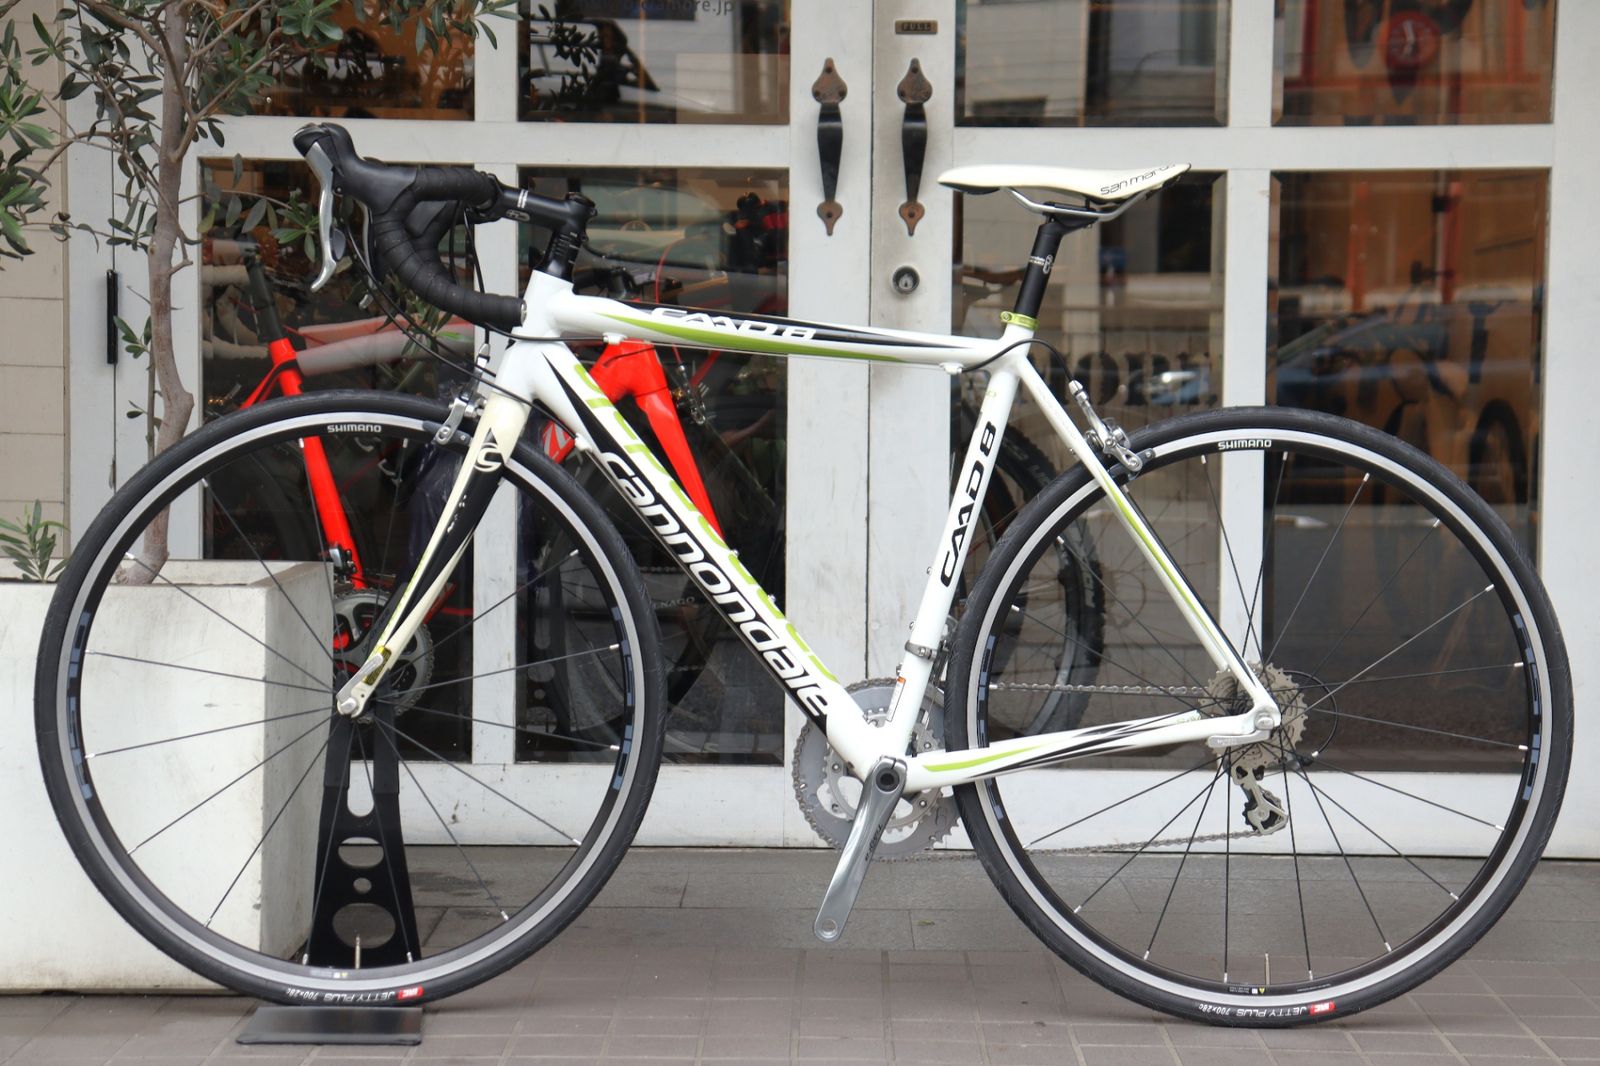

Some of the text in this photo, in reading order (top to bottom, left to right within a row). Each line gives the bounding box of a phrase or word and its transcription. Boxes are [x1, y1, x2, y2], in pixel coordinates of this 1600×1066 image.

[327, 423, 382, 433] SHIMANO
[1218, 439, 1272, 450] SHIMANO
[600, 451, 829, 717] cannondale
[323, 993, 355, 1002] PLUS
[356, 991, 396, 1002] JETTY
[1236, 1008, 1267, 1018] PLUS
[1269, 1006, 1308, 1017] JETTY
